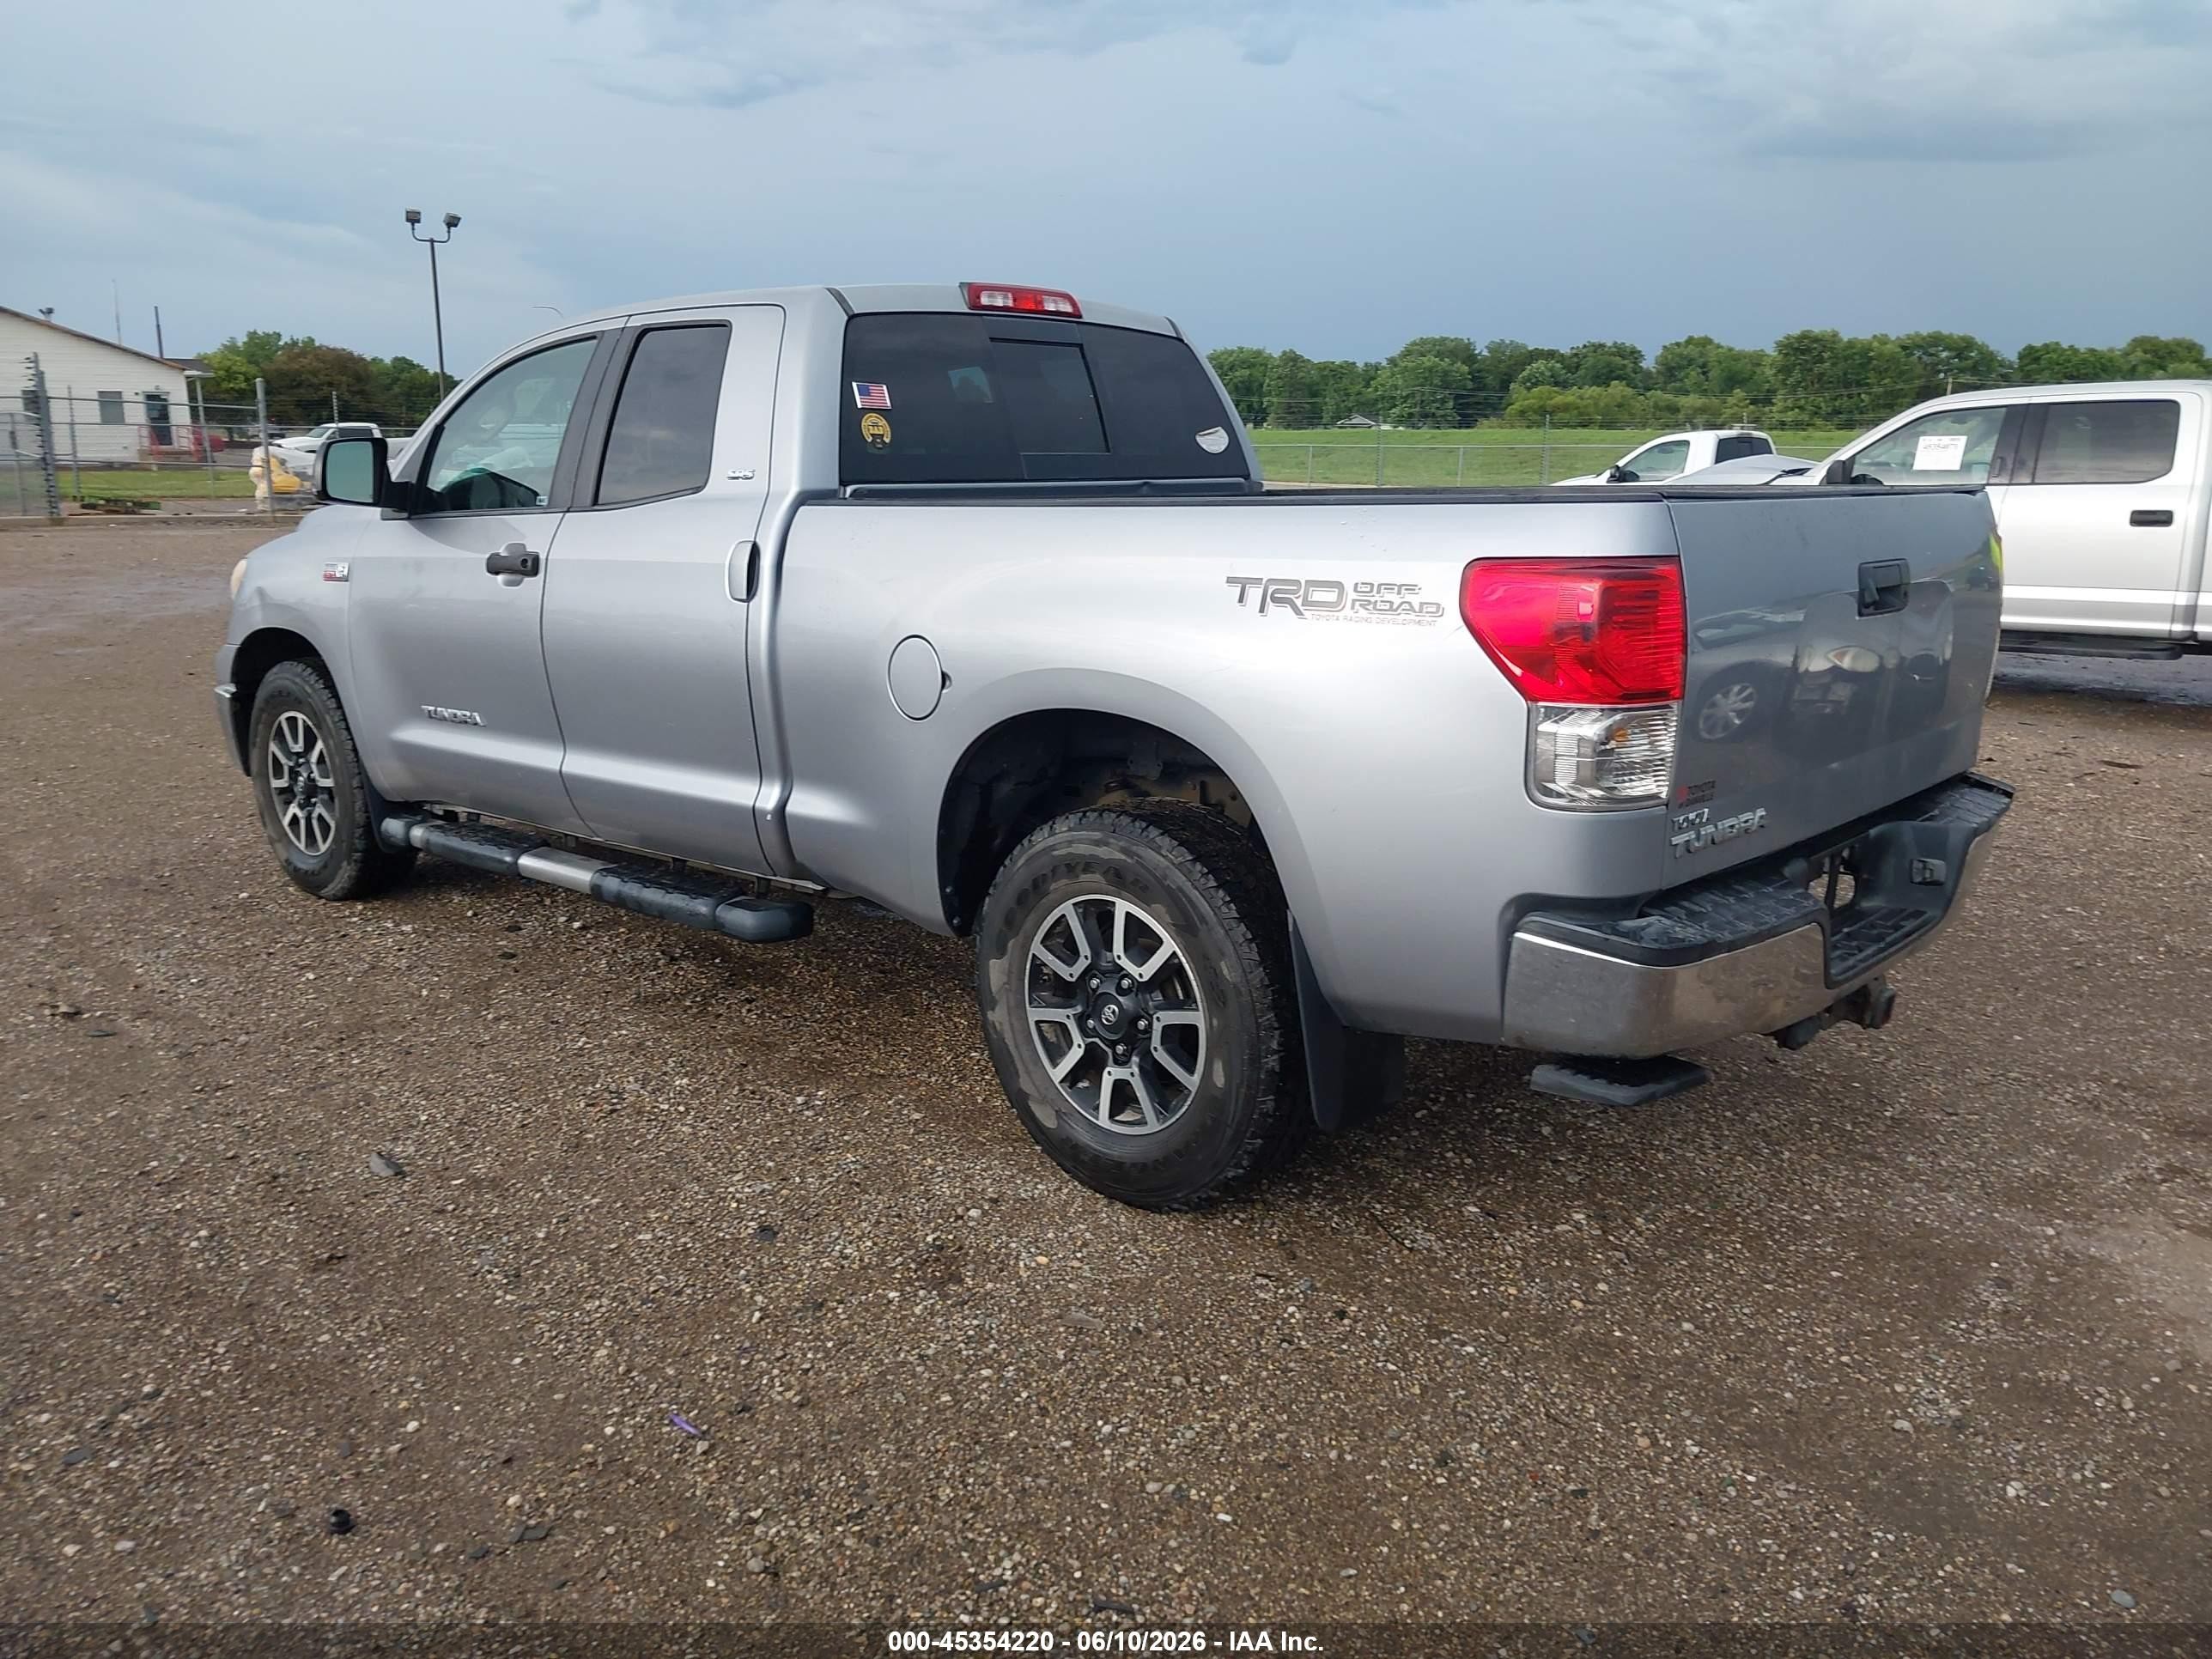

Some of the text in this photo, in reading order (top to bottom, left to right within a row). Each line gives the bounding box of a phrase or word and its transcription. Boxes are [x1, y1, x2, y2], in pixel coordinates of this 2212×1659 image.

[1225, 576, 1347, 619] TRD
[1352, 581, 1422, 598] OFF
[1350, 599, 1444, 617] ROAD
[1310, 613, 1340, 622] TOYOTA
[1669, 807, 1767, 859] TUNDRA
